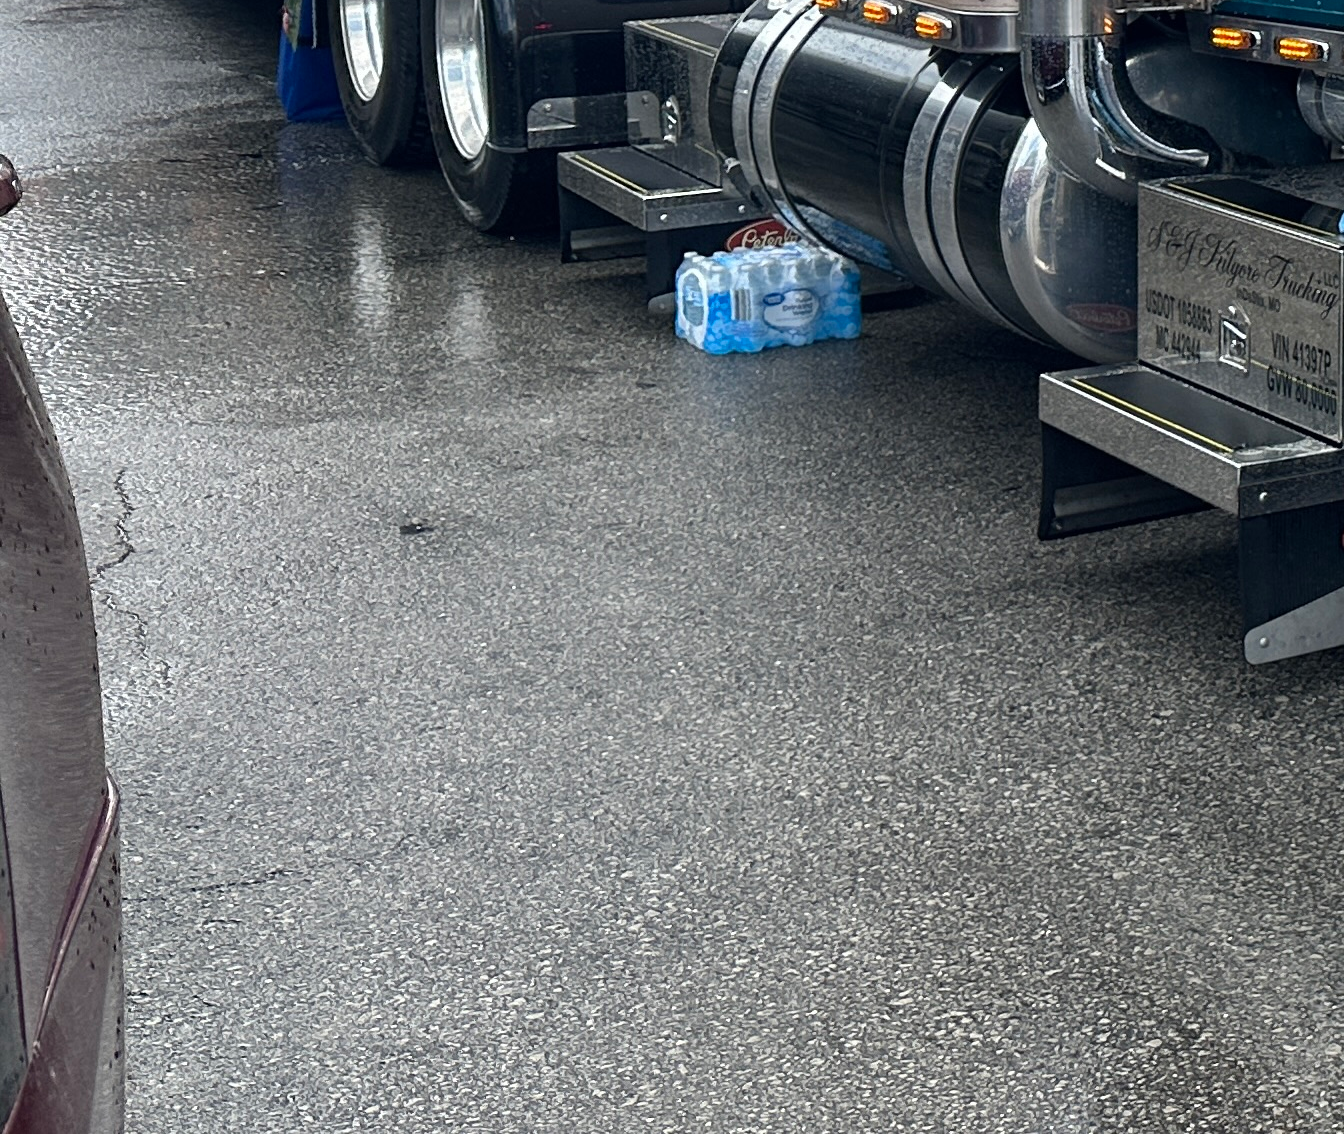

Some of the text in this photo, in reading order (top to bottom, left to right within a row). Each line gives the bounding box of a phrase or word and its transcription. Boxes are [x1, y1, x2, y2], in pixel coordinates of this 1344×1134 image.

[1145, 288, 1175, 320] USDOT
[1263, 254, 1342, 320] Trucking
[1271, 330, 1332, 379] VIN 41397P
[1266, 364, 1293, 399] GVW
